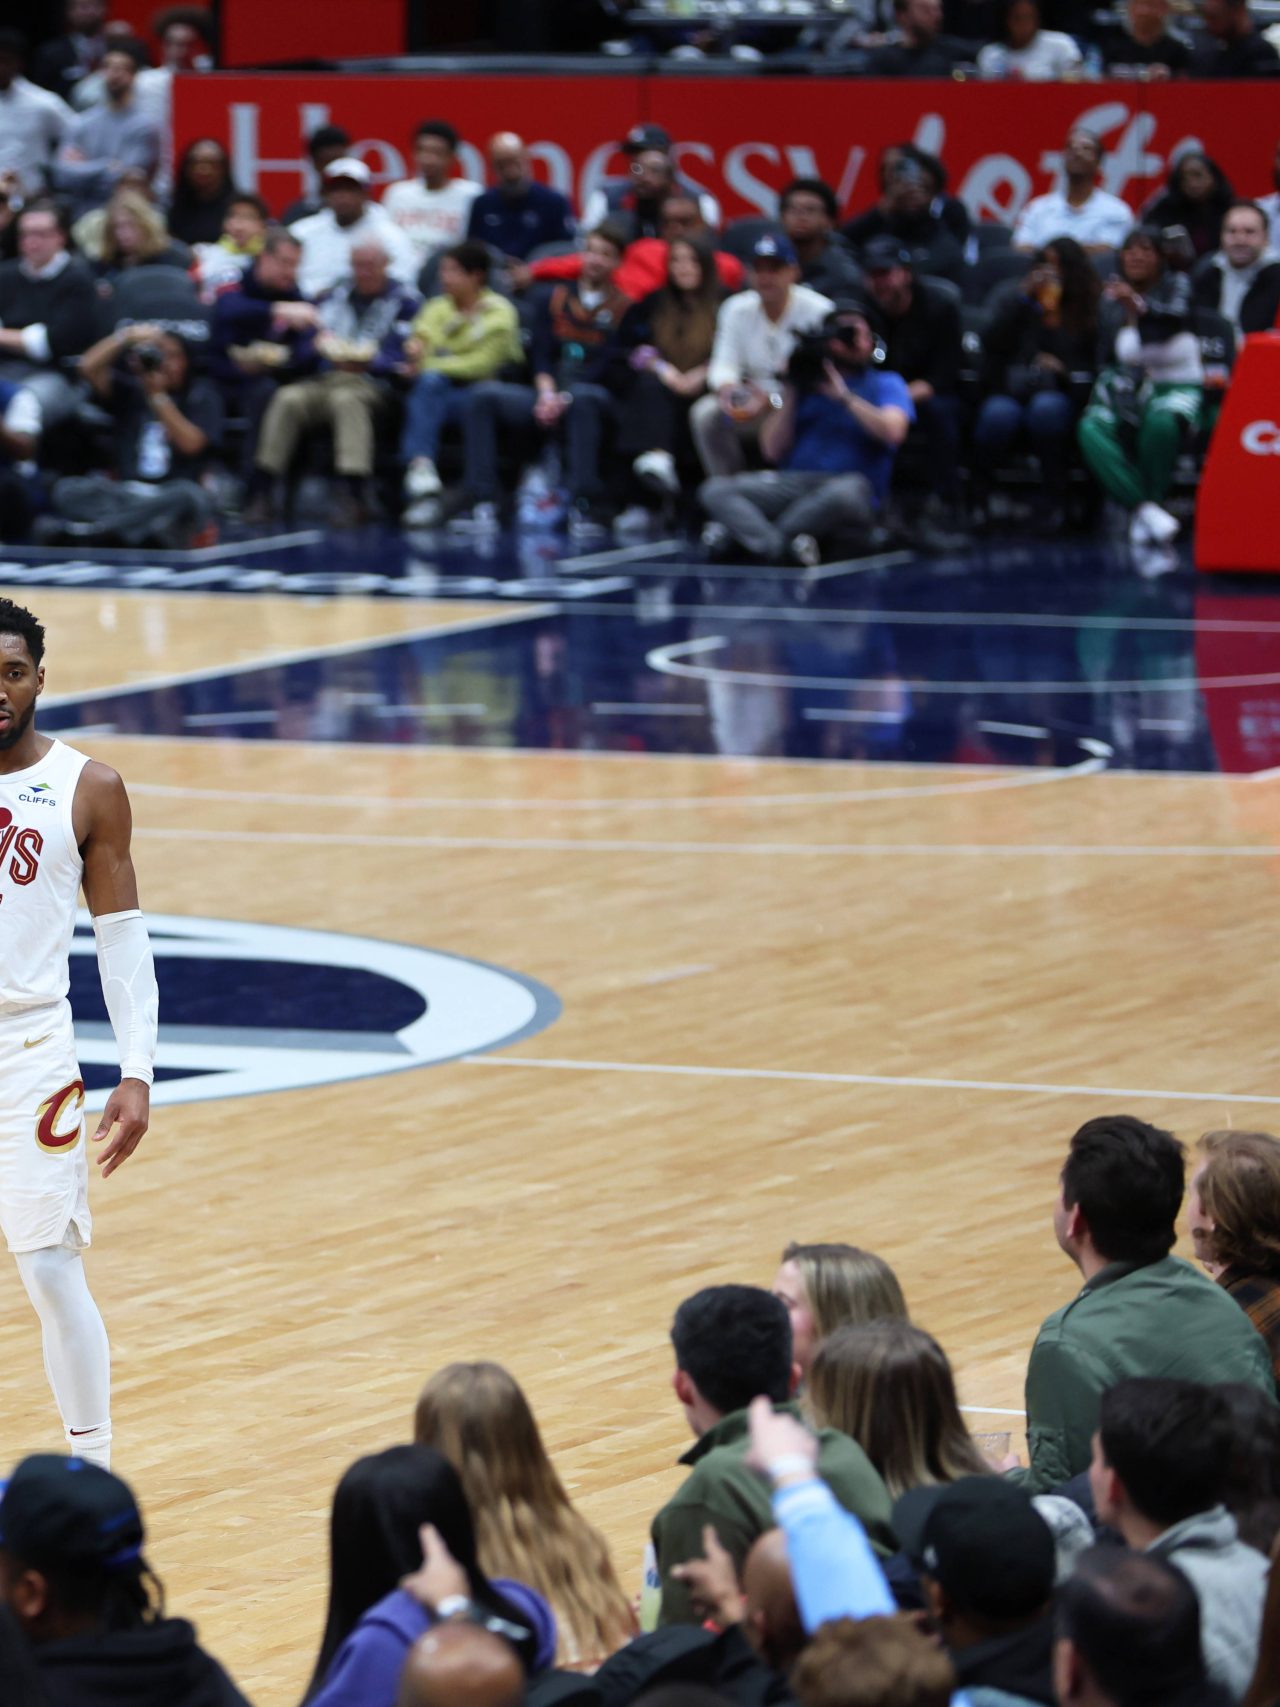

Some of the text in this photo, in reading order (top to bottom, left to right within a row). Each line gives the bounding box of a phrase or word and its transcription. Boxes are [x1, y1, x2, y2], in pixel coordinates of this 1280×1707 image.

[1240, 419, 1280, 457] C
[18, 793, 56, 807] CLIFFS
[35, 1078, 86, 1154] C
